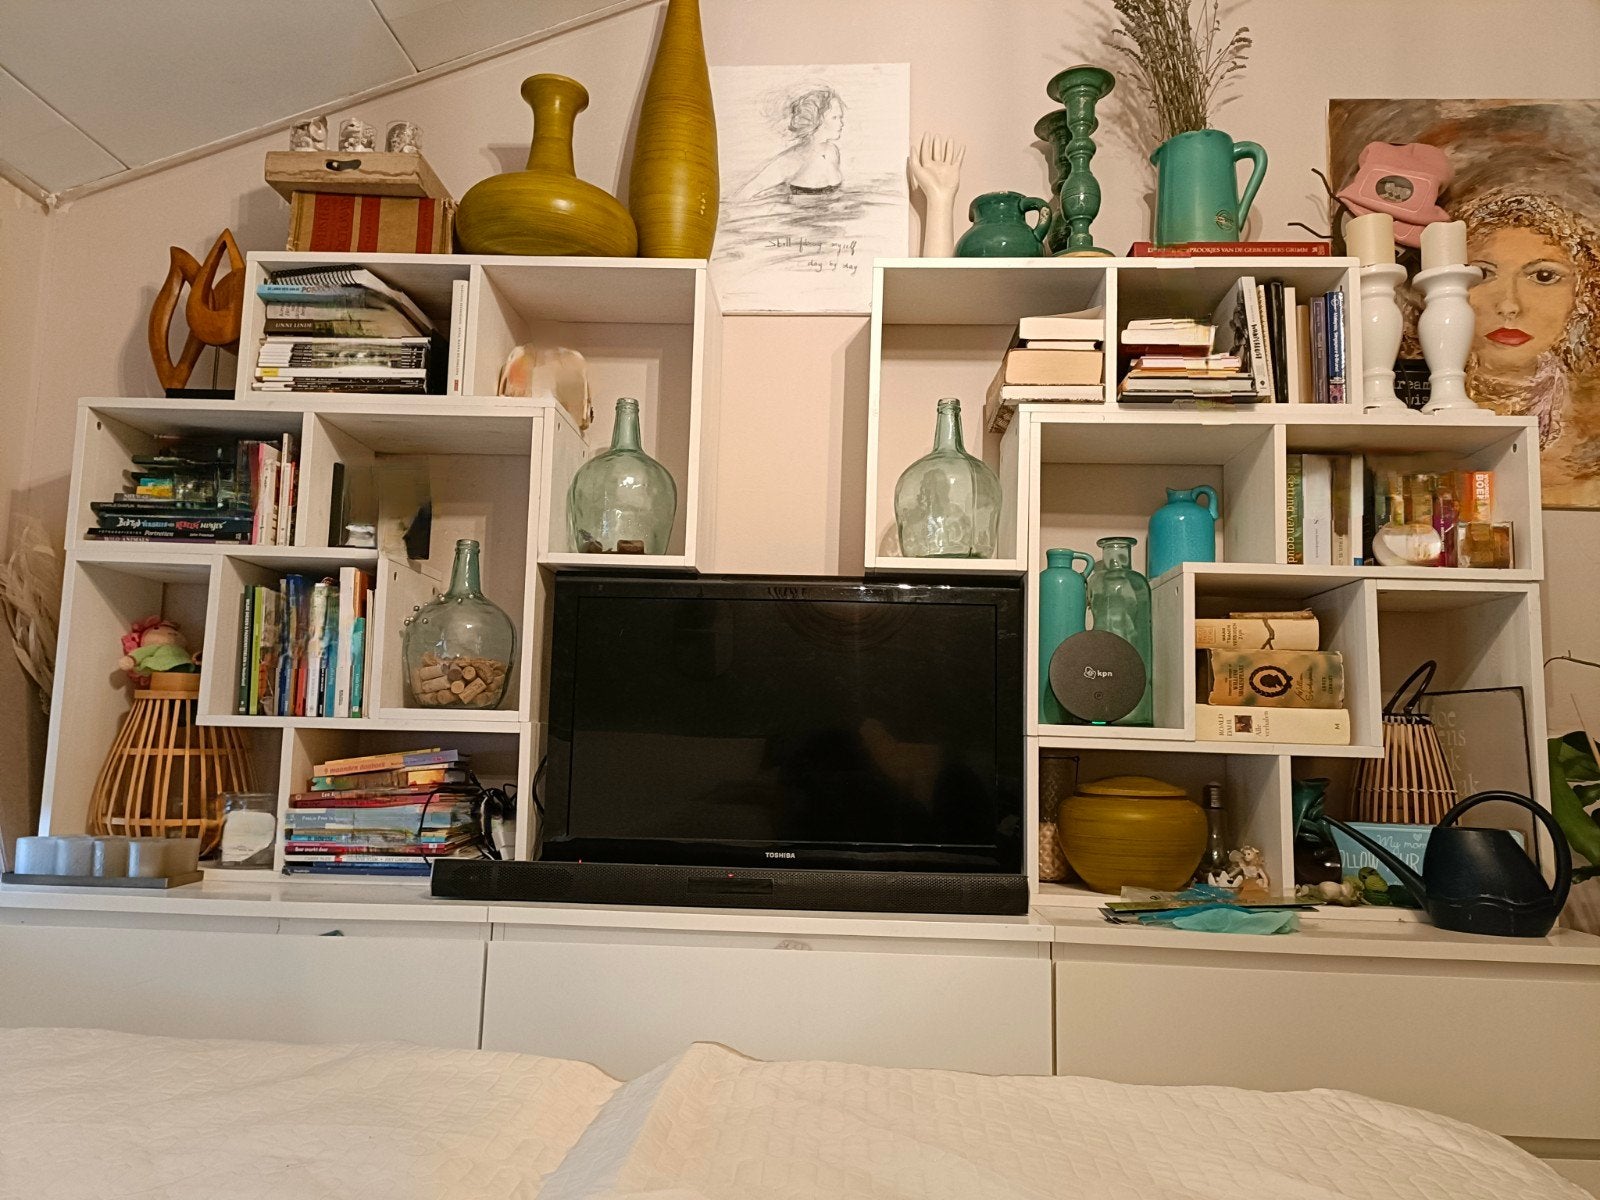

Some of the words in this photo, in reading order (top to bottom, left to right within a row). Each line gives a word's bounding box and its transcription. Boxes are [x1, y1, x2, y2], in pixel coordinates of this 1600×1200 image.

[766, 238, 791, 247] Still
[832, 240, 857, 256] myself
[808, 260, 822, 272] day
[829, 261, 837, 271] by
[843, 262, 858, 275] day
[1394, 380, 1430, 390] ream
[1287, 514, 1297, 534] van
[1377, 835, 1400, 854] My
